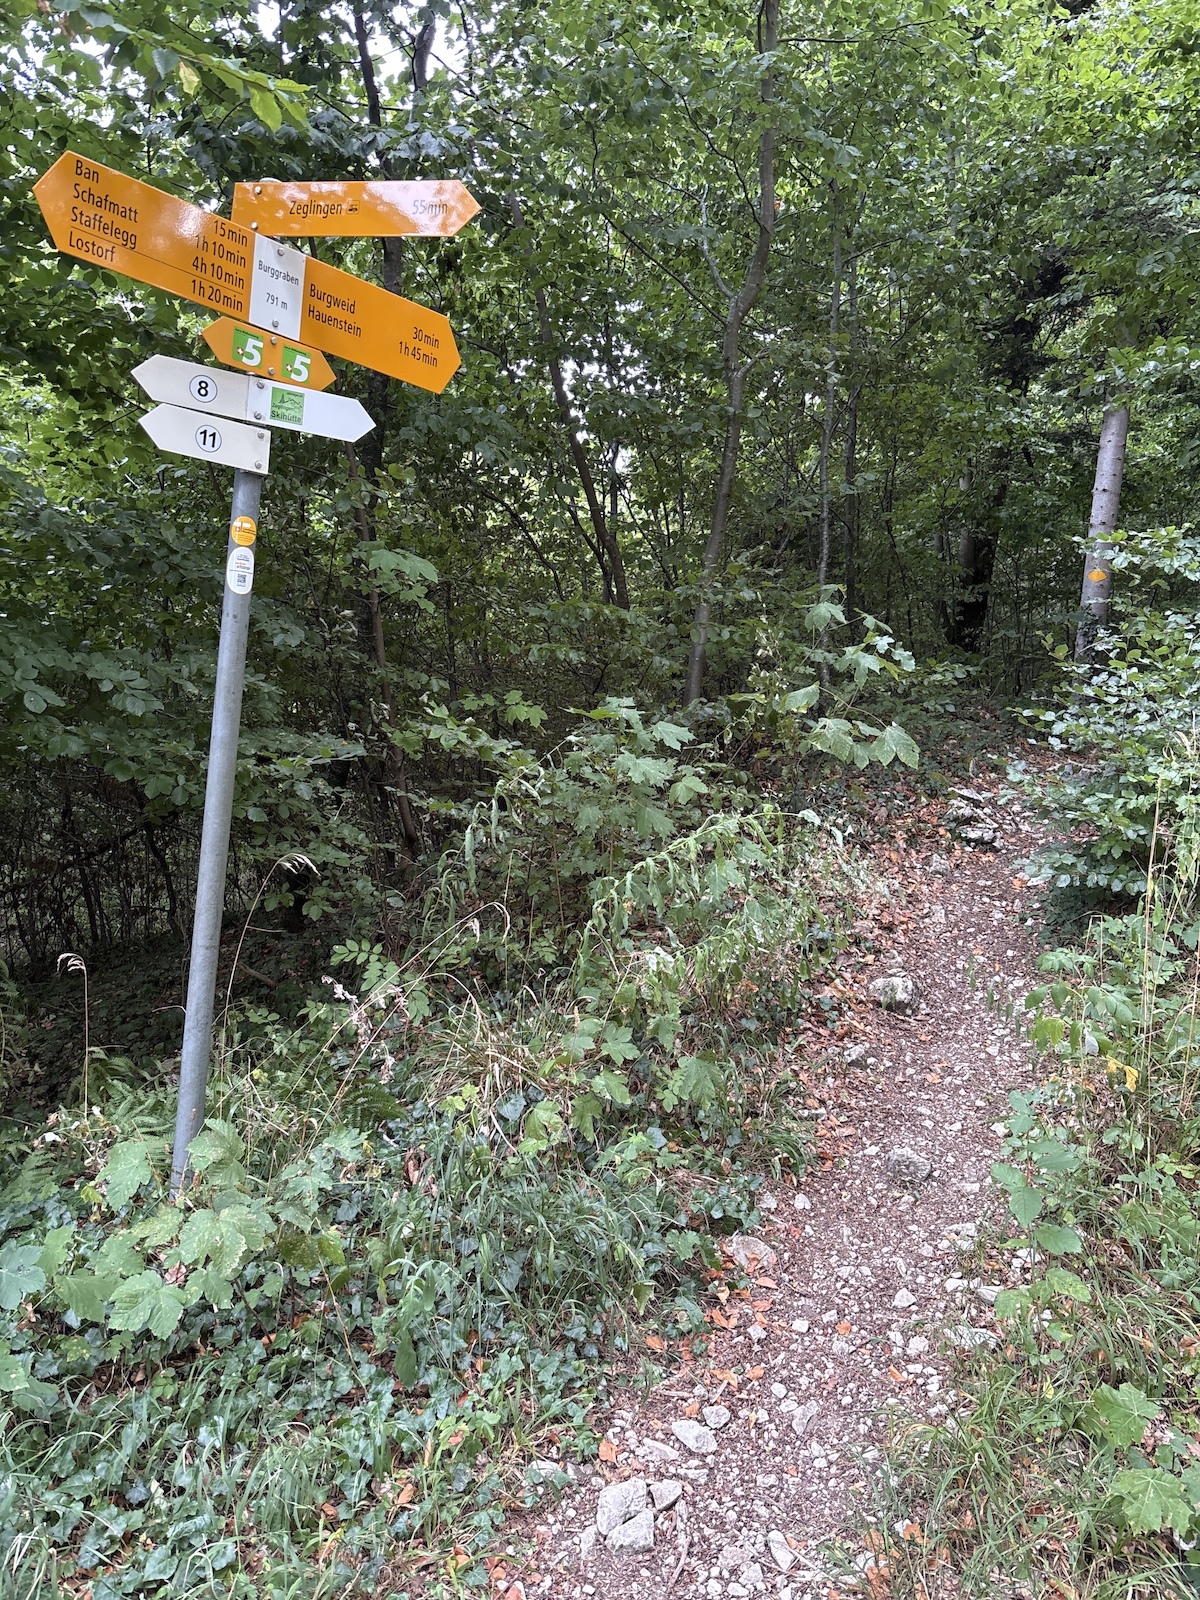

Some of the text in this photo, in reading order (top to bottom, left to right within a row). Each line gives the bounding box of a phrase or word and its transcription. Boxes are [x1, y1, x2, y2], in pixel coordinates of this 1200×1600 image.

[75, 159, 99, 183] Ban
[73, 183, 139, 223] Schafmatt
[289, 199, 343, 219] Zeglingen
[71, 206, 137, 250] Staffelegg
[69, 231, 116, 263] Lostorf
[258, 259, 299, 286] Burggraben
[266, 292, 288, 310] 791 m
[309, 283, 356, 315] Burgweid
[307, 305, 362, 338] Hauenstein
[242, 337, 264, 367] 5
[290, 354, 312, 382] 5
[197, 380, 209, 397] 8
[270, 410, 302, 423] Skihütte
[199, 429, 218, 448] 11
